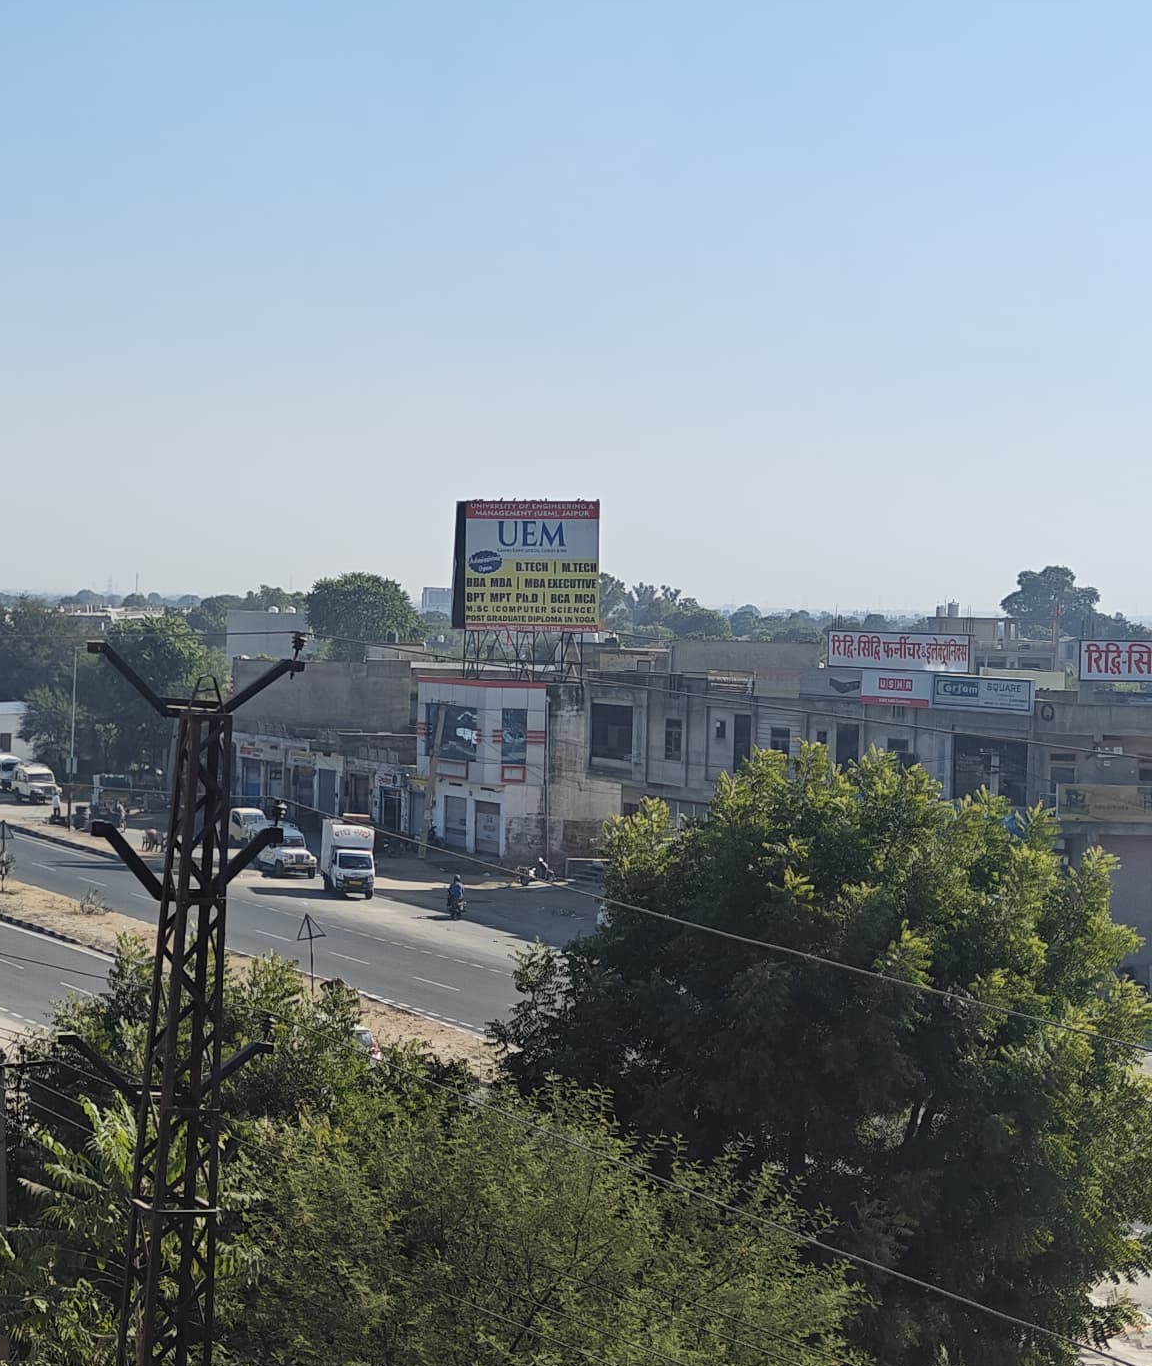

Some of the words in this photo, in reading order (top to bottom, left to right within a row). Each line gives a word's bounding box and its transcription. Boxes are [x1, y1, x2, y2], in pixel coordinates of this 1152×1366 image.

[470, 502, 516, 510] UNIVERSITY
[497, 521, 567, 547] UEM
[515, 562, 549, 572] B.TECH
[561, 562, 597, 573] M.TECH
[466, 578, 486, 588] BBA
[490, 578, 512, 588] MBA
[524, 578, 546, 588] MBA
[547, 578, 597, 589] EXECUTIVE
[466, 592, 486, 602] BPT
[490, 592, 512, 603] MPT
[515, 592, 538, 603] Ph.D
[550, 593, 570, 604] BCA
[574, 594, 596, 604] MCA
[466, 605, 489, 613] M.SC
[492, 605, 547, 613] (COMPUTER
[550, 606, 596, 614] SCIENCE)
[528, 615, 563, 623] DIPLOMA
[879, 677, 913, 691] USHA
[986, 682, 1023, 693] SQUARE
